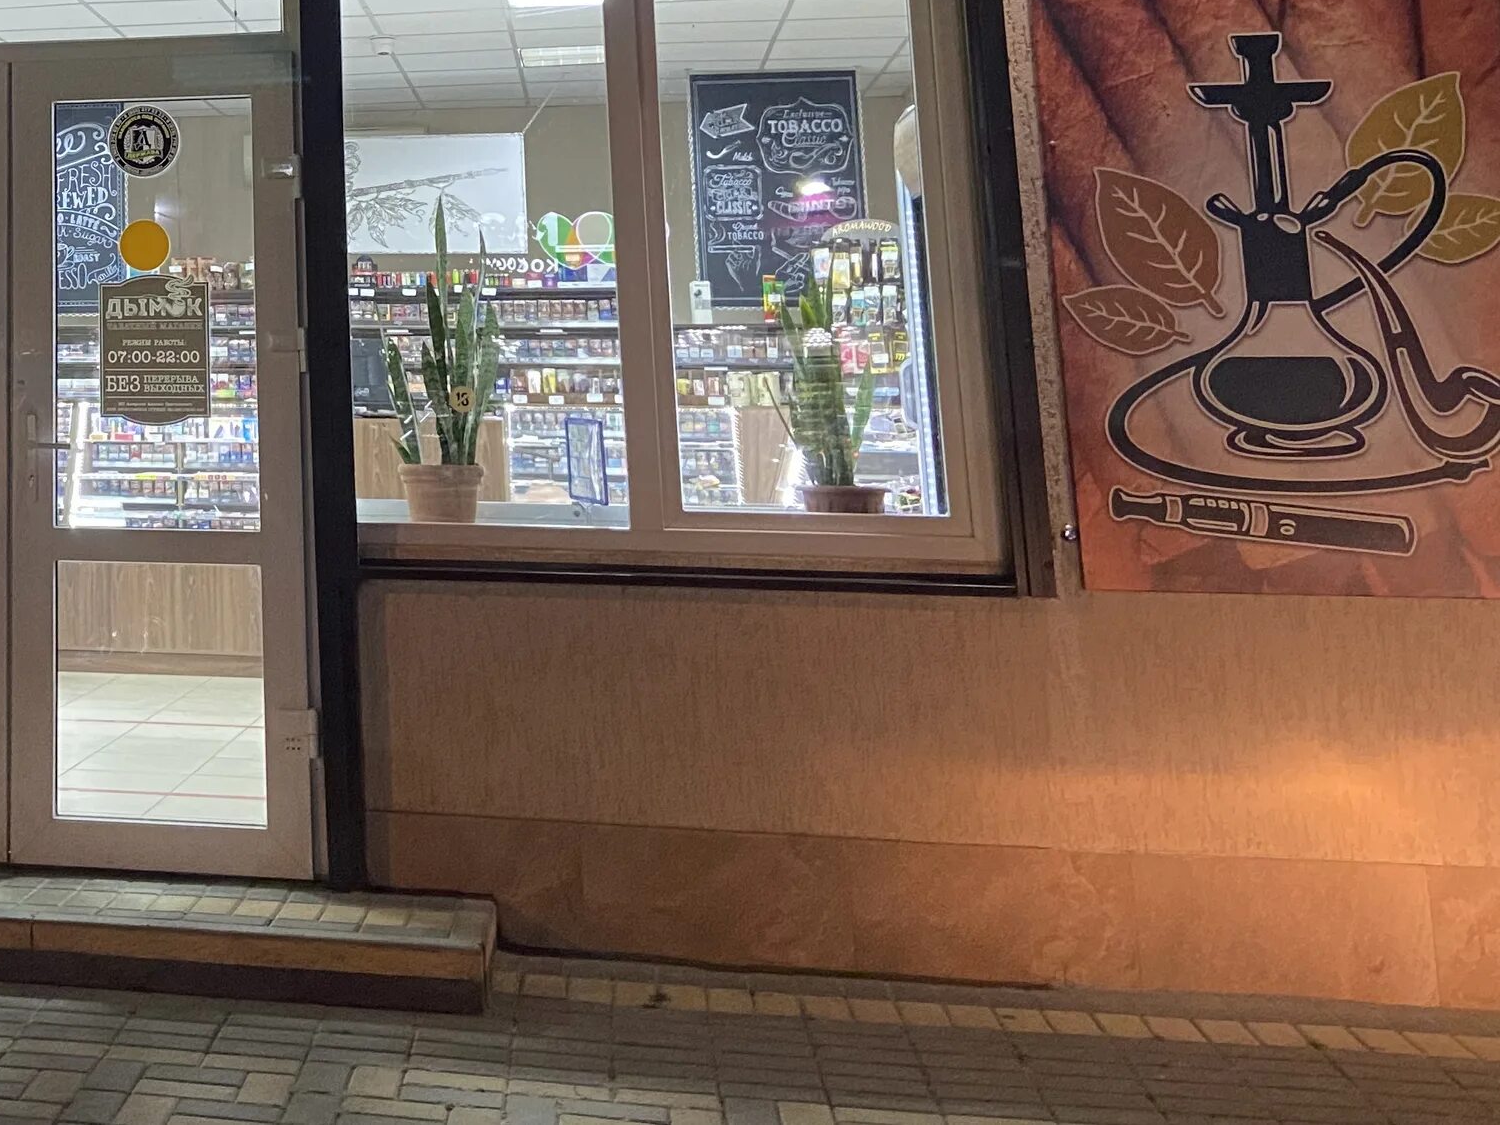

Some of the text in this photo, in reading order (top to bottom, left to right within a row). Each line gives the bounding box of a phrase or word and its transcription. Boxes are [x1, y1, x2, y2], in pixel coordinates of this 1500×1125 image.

[767, 118, 843, 134] TOBACCO
[727, 230, 764, 241] TOBACCO
[832, 221, 893, 237] AROMAWOOD
[107, 350, 200, 364] 07:00-22:00
[105, 375, 200, 393] БЕЗ ПЕРЕРЫВА
[143, 383, 206, 394] ВЫХОДНЫХ
